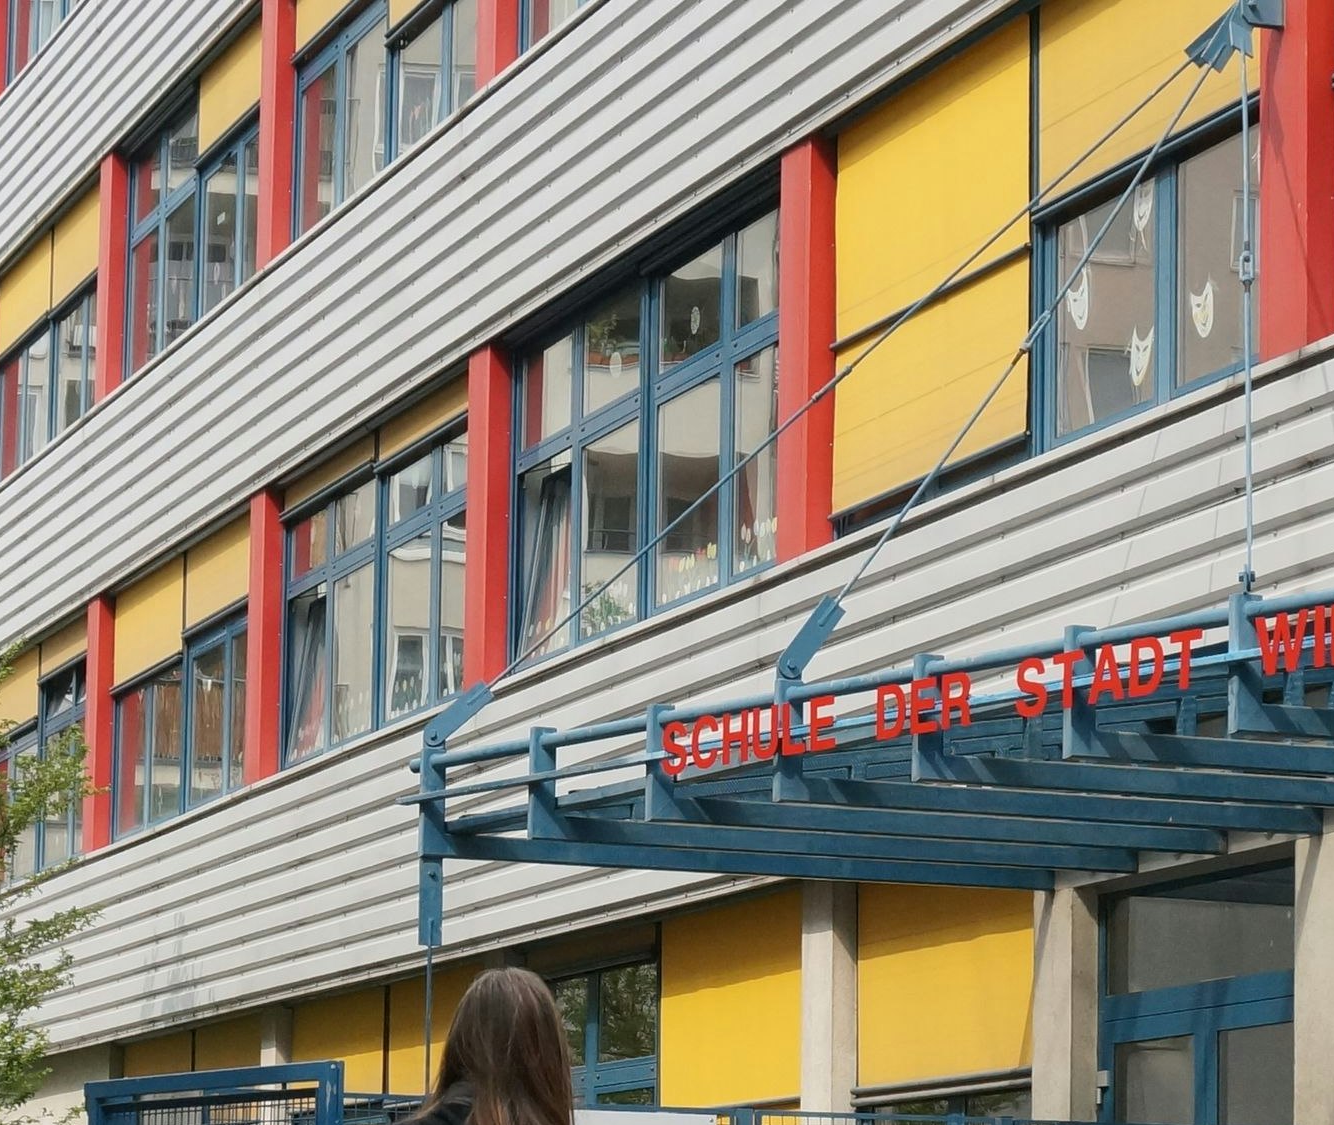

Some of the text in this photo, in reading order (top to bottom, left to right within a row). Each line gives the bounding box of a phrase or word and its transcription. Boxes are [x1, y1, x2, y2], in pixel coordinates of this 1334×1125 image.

[661, 695, 837, 776] SCHULE
[875, 672, 972, 741] DER
[1014, 628, 1204, 719] STADT
